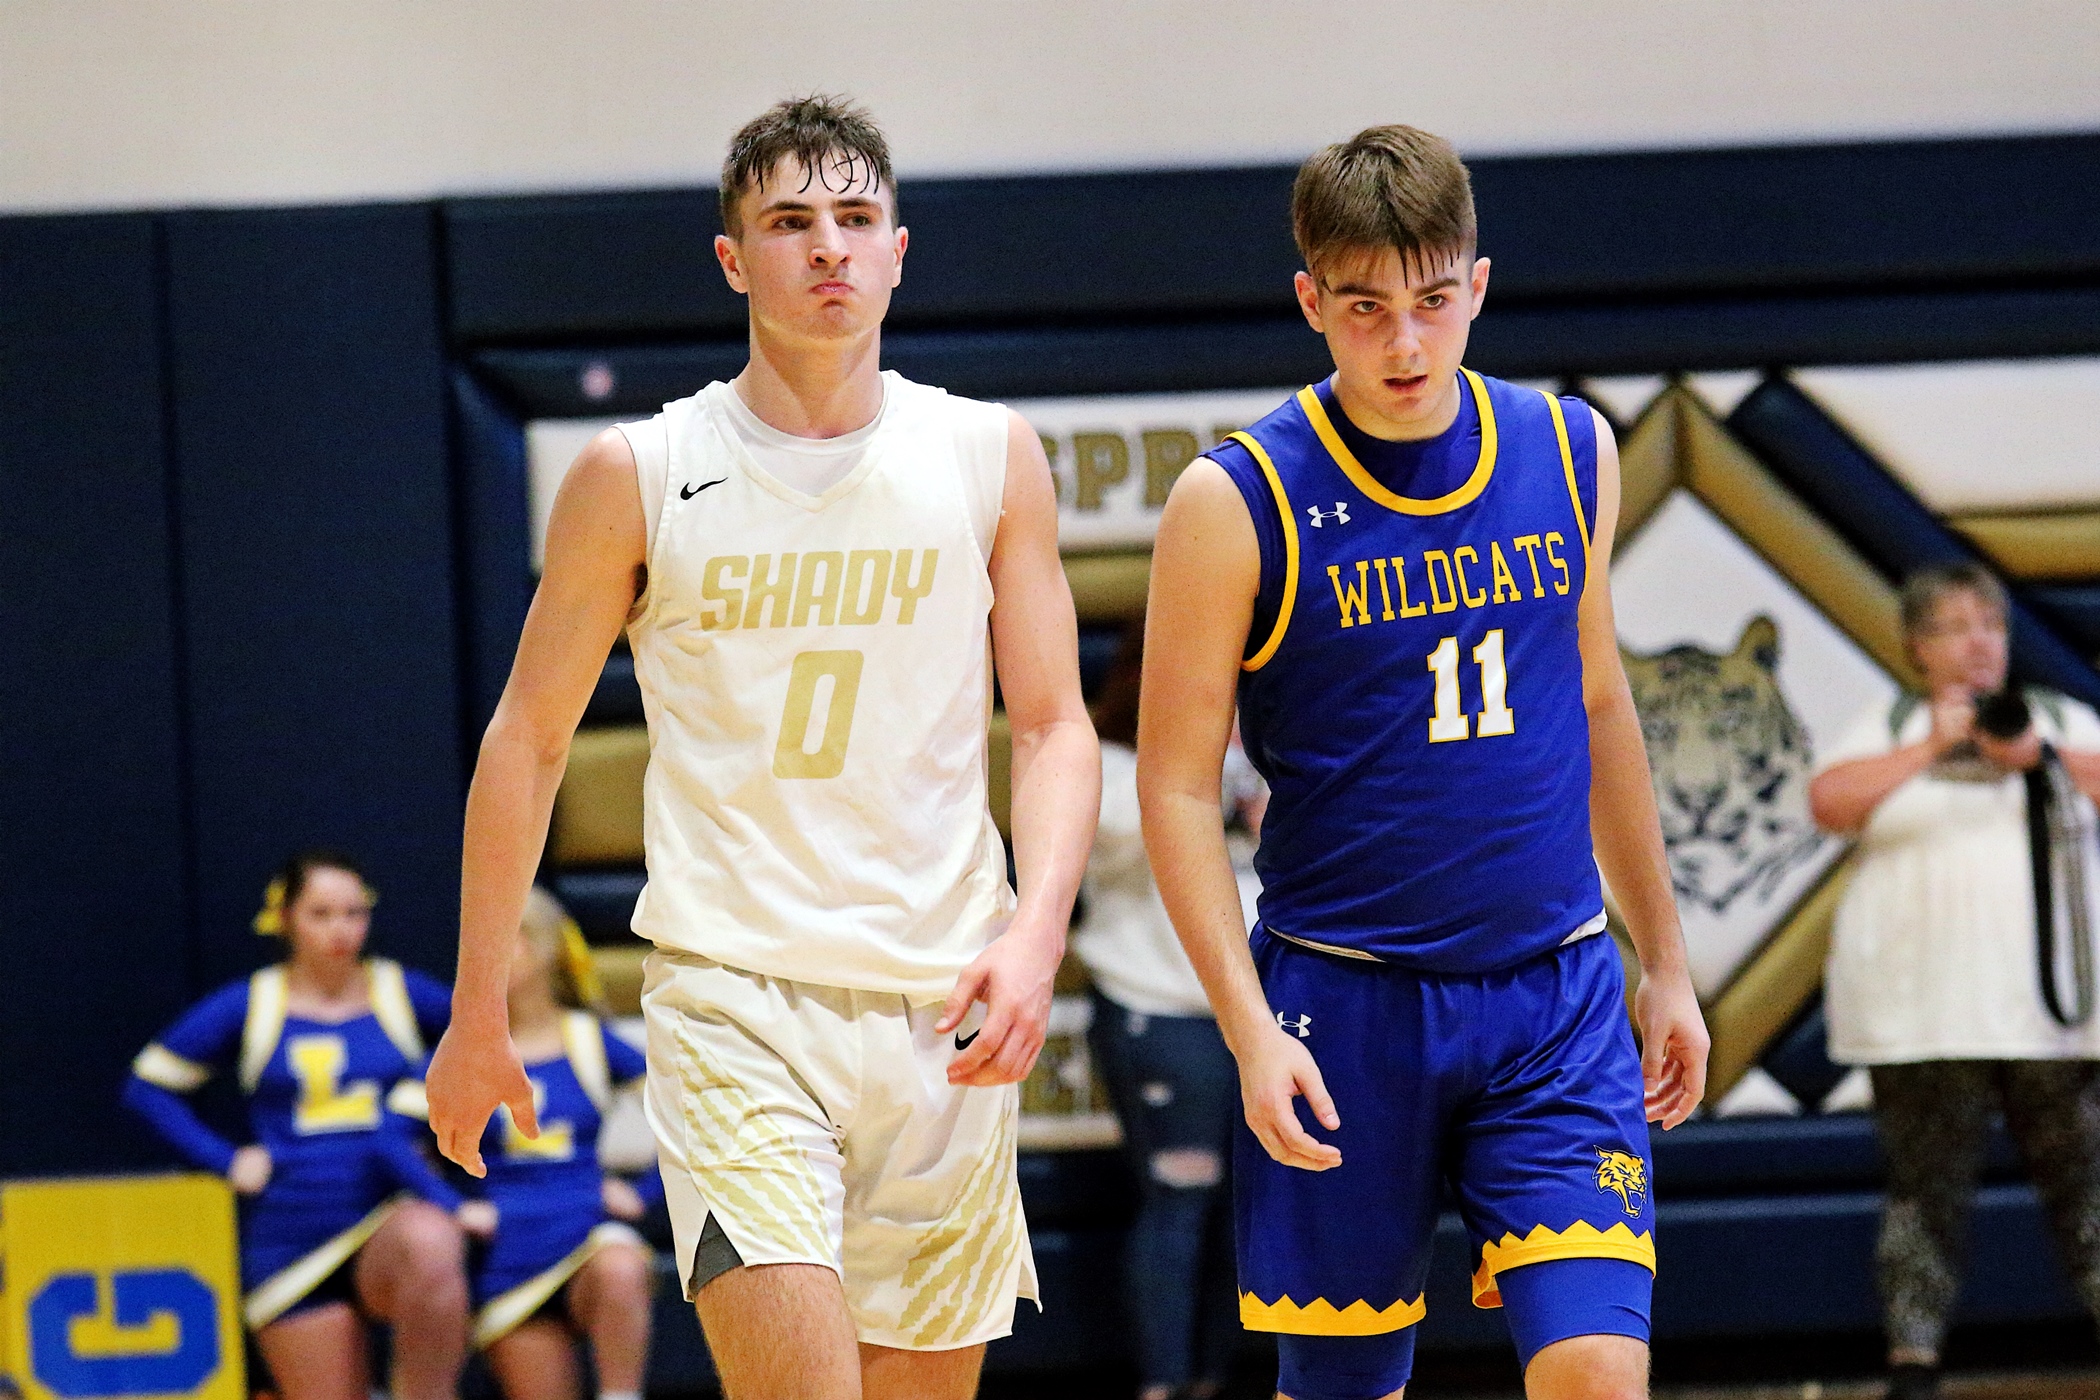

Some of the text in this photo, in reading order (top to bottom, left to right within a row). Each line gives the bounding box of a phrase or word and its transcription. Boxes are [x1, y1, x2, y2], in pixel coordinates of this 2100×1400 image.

[701, 548, 938, 631] SHADY
[1327, 531, 1570, 628] WILDCATS
[772, 649, 864, 779] 0
[1427, 629, 1515, 743] 11
[287, 1034, 381, 1133] L
